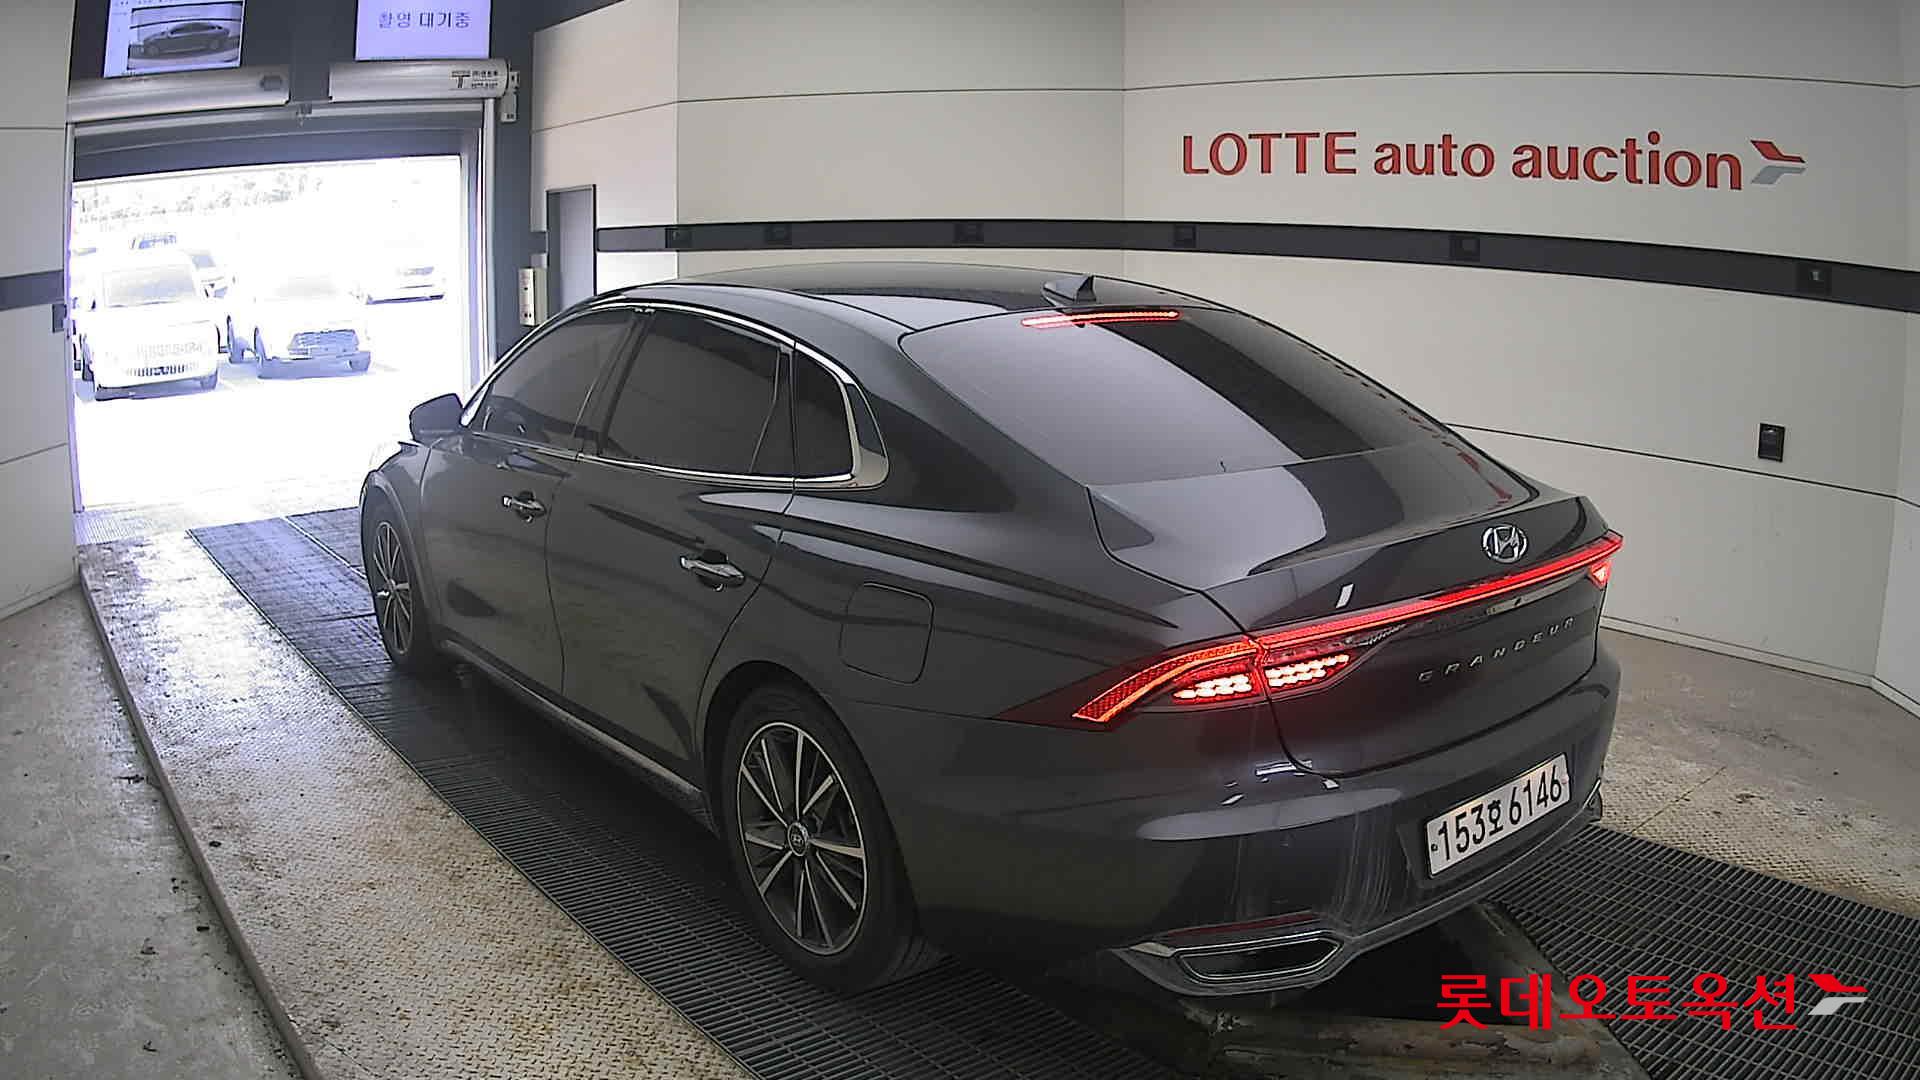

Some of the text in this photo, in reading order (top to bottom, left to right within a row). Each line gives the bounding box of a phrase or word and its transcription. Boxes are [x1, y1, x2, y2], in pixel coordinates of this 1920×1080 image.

[419, 11, 472, 29] 대기중
[1183, 131, 1743, 191] LOTTE auto auction
[1418, 617, 1575, 682] GRANDEUR
